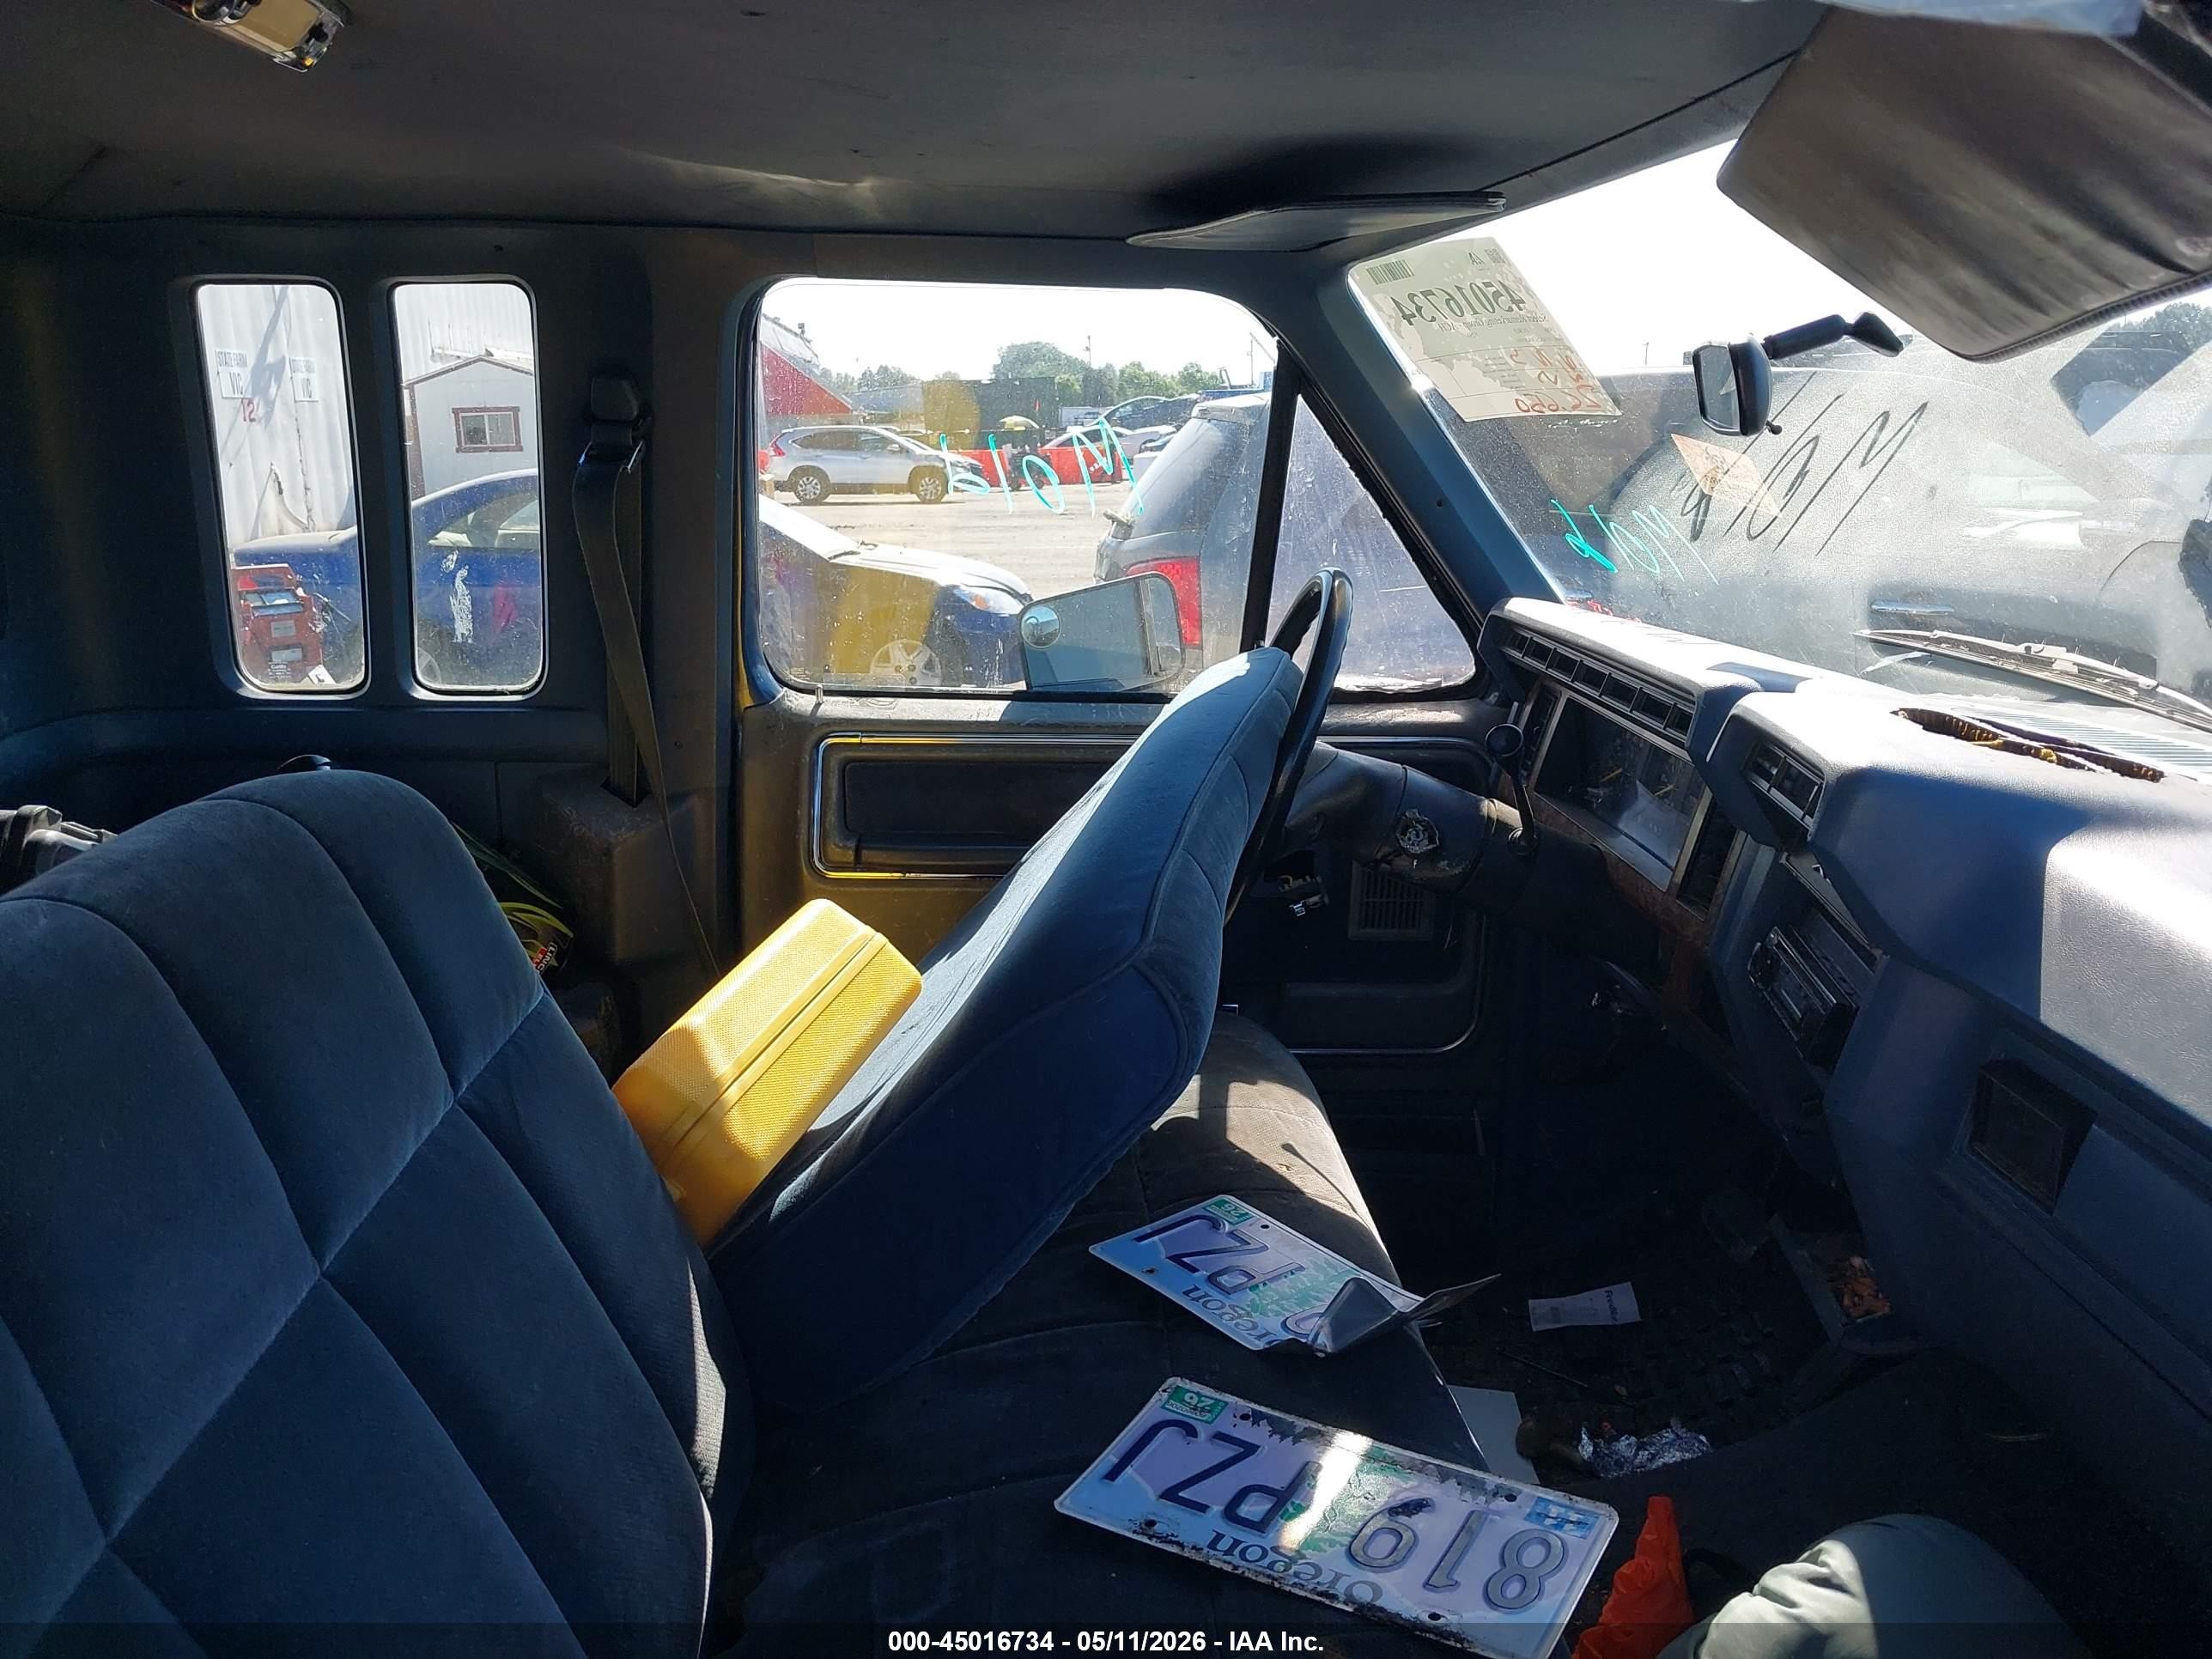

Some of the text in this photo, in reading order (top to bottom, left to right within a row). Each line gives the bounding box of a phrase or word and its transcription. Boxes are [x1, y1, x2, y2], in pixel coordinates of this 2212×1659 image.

[1133, 1213, 1306, 1296] PZJ
[1101, 1419, 1569, 1613] 819 PZJ
[1206, 1528, 1384, 1606] Oregon
